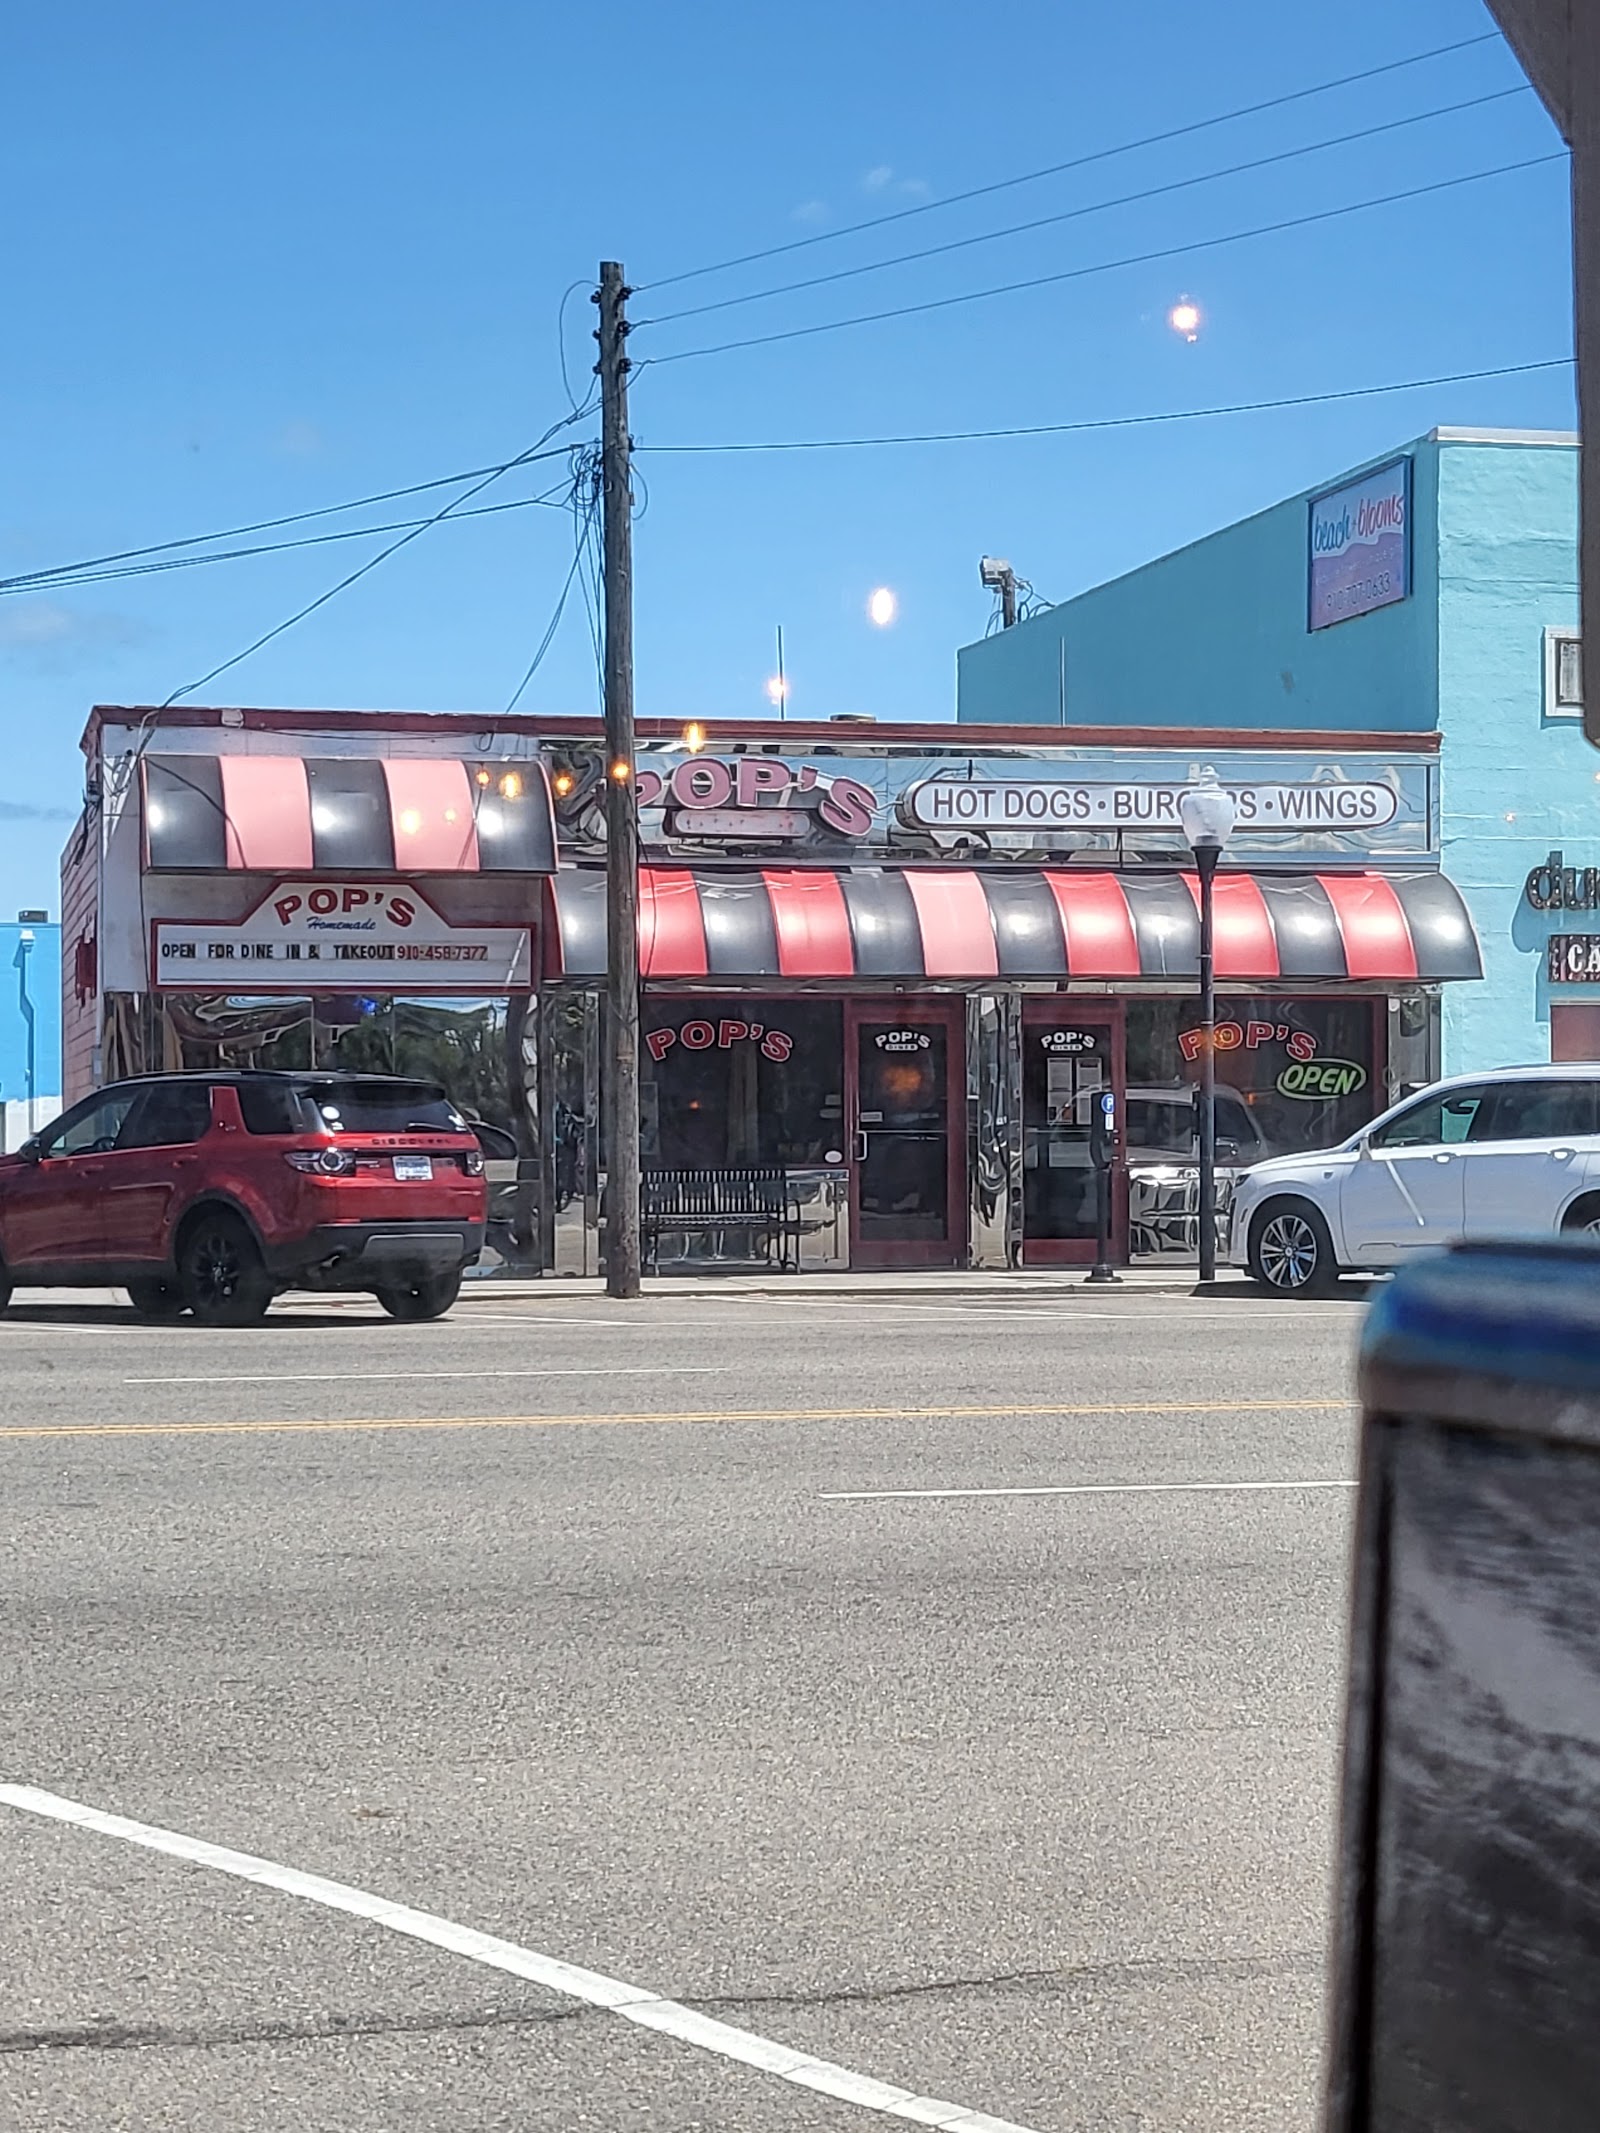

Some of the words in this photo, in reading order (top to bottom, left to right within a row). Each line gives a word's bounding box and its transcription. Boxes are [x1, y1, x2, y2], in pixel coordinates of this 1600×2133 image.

[1315, 505, 1350, 551] beach
[1358, 495, 1404, 537] blooms
[1327, 573, 1391, 610] 910-707-0633
[934, 788, 996, 818] HOT
[1004, 789, 1091, 819] DOGS
[1114, 790, 1257, 819] BURS
[1279, 790, 1377, 819] WINGS
[1526, 850, 1600, 910] du
[274, 888, 416, 927] POP'S
[307, 916, 376, 930] Homemade
[161, 943, 196, 959] OPEN
[207, 944, 234, 959] FOR
[241, 944, 274, 959] DINE
[286, 944, 300, 959] IN
[308, 944, 320, 960] &
[333, 944, 395, 960] TAKEOUT
[397, 945, 487, 961] 910-458-7377
[645, 1019, 793, 1062] POP'S
[875, 1031, 931, 1048] POP'S
[1041, 1032, 1095, 1048] POP'S
[1178, 1021, 1317, 1061] POP'S
[1284, 1065, 1357, 1094] OPEN
